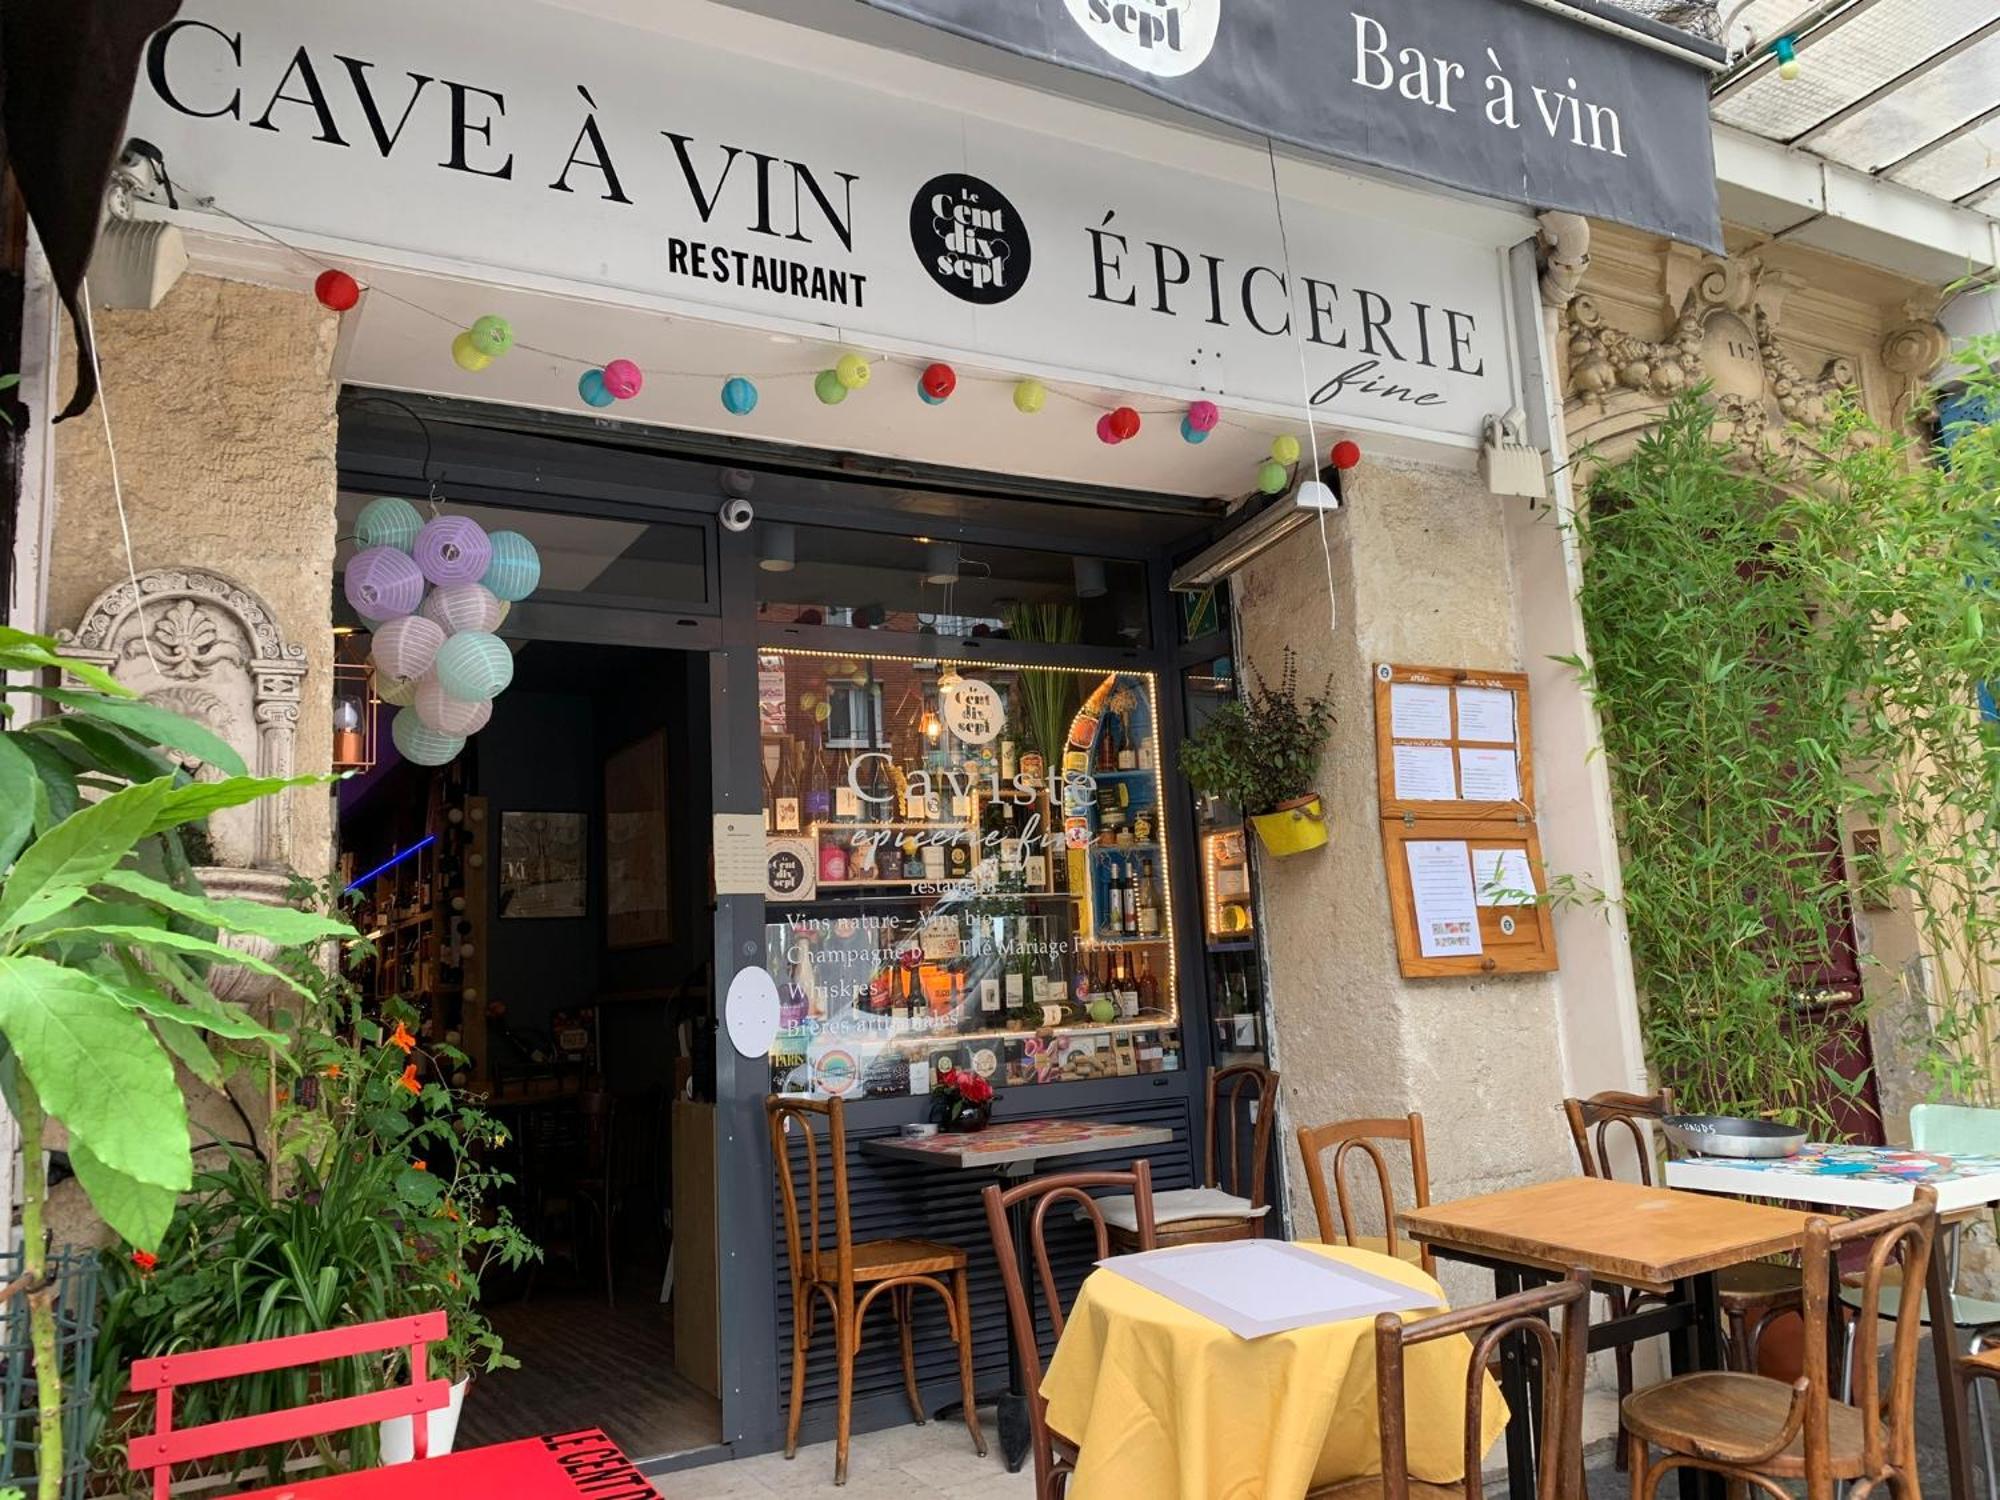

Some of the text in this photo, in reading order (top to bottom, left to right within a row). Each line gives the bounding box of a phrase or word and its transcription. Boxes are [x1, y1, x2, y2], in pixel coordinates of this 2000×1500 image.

[1351, 12, 1627, 158] Bar à vin
[146, 20, 859, 253] CAVE À VIN
[931, 193, 1006, 232] Cent
[944, 220, 995, 259] dix
[668, 237, 867, 308] RESTAURANT
[936, 254, 1007, 289] sept
[1084, 210, 1485, 378] ÉPICERIE
[1309, 360, 1446, 405] fine
[847, 752, 1098, 806] Caviste
[786, 913, 829, 931] Vins
[837, 914, 900, 930] nature
[917, 908, 958, 929] Vins
[965, 908, 992, 926] bio
[787, 946, 906, 967] Champagne
[959, 937, 993, 957] Thé
[995, 936, 1069, 963] Mariage
[788, 978, 878, 999] Whiskies
